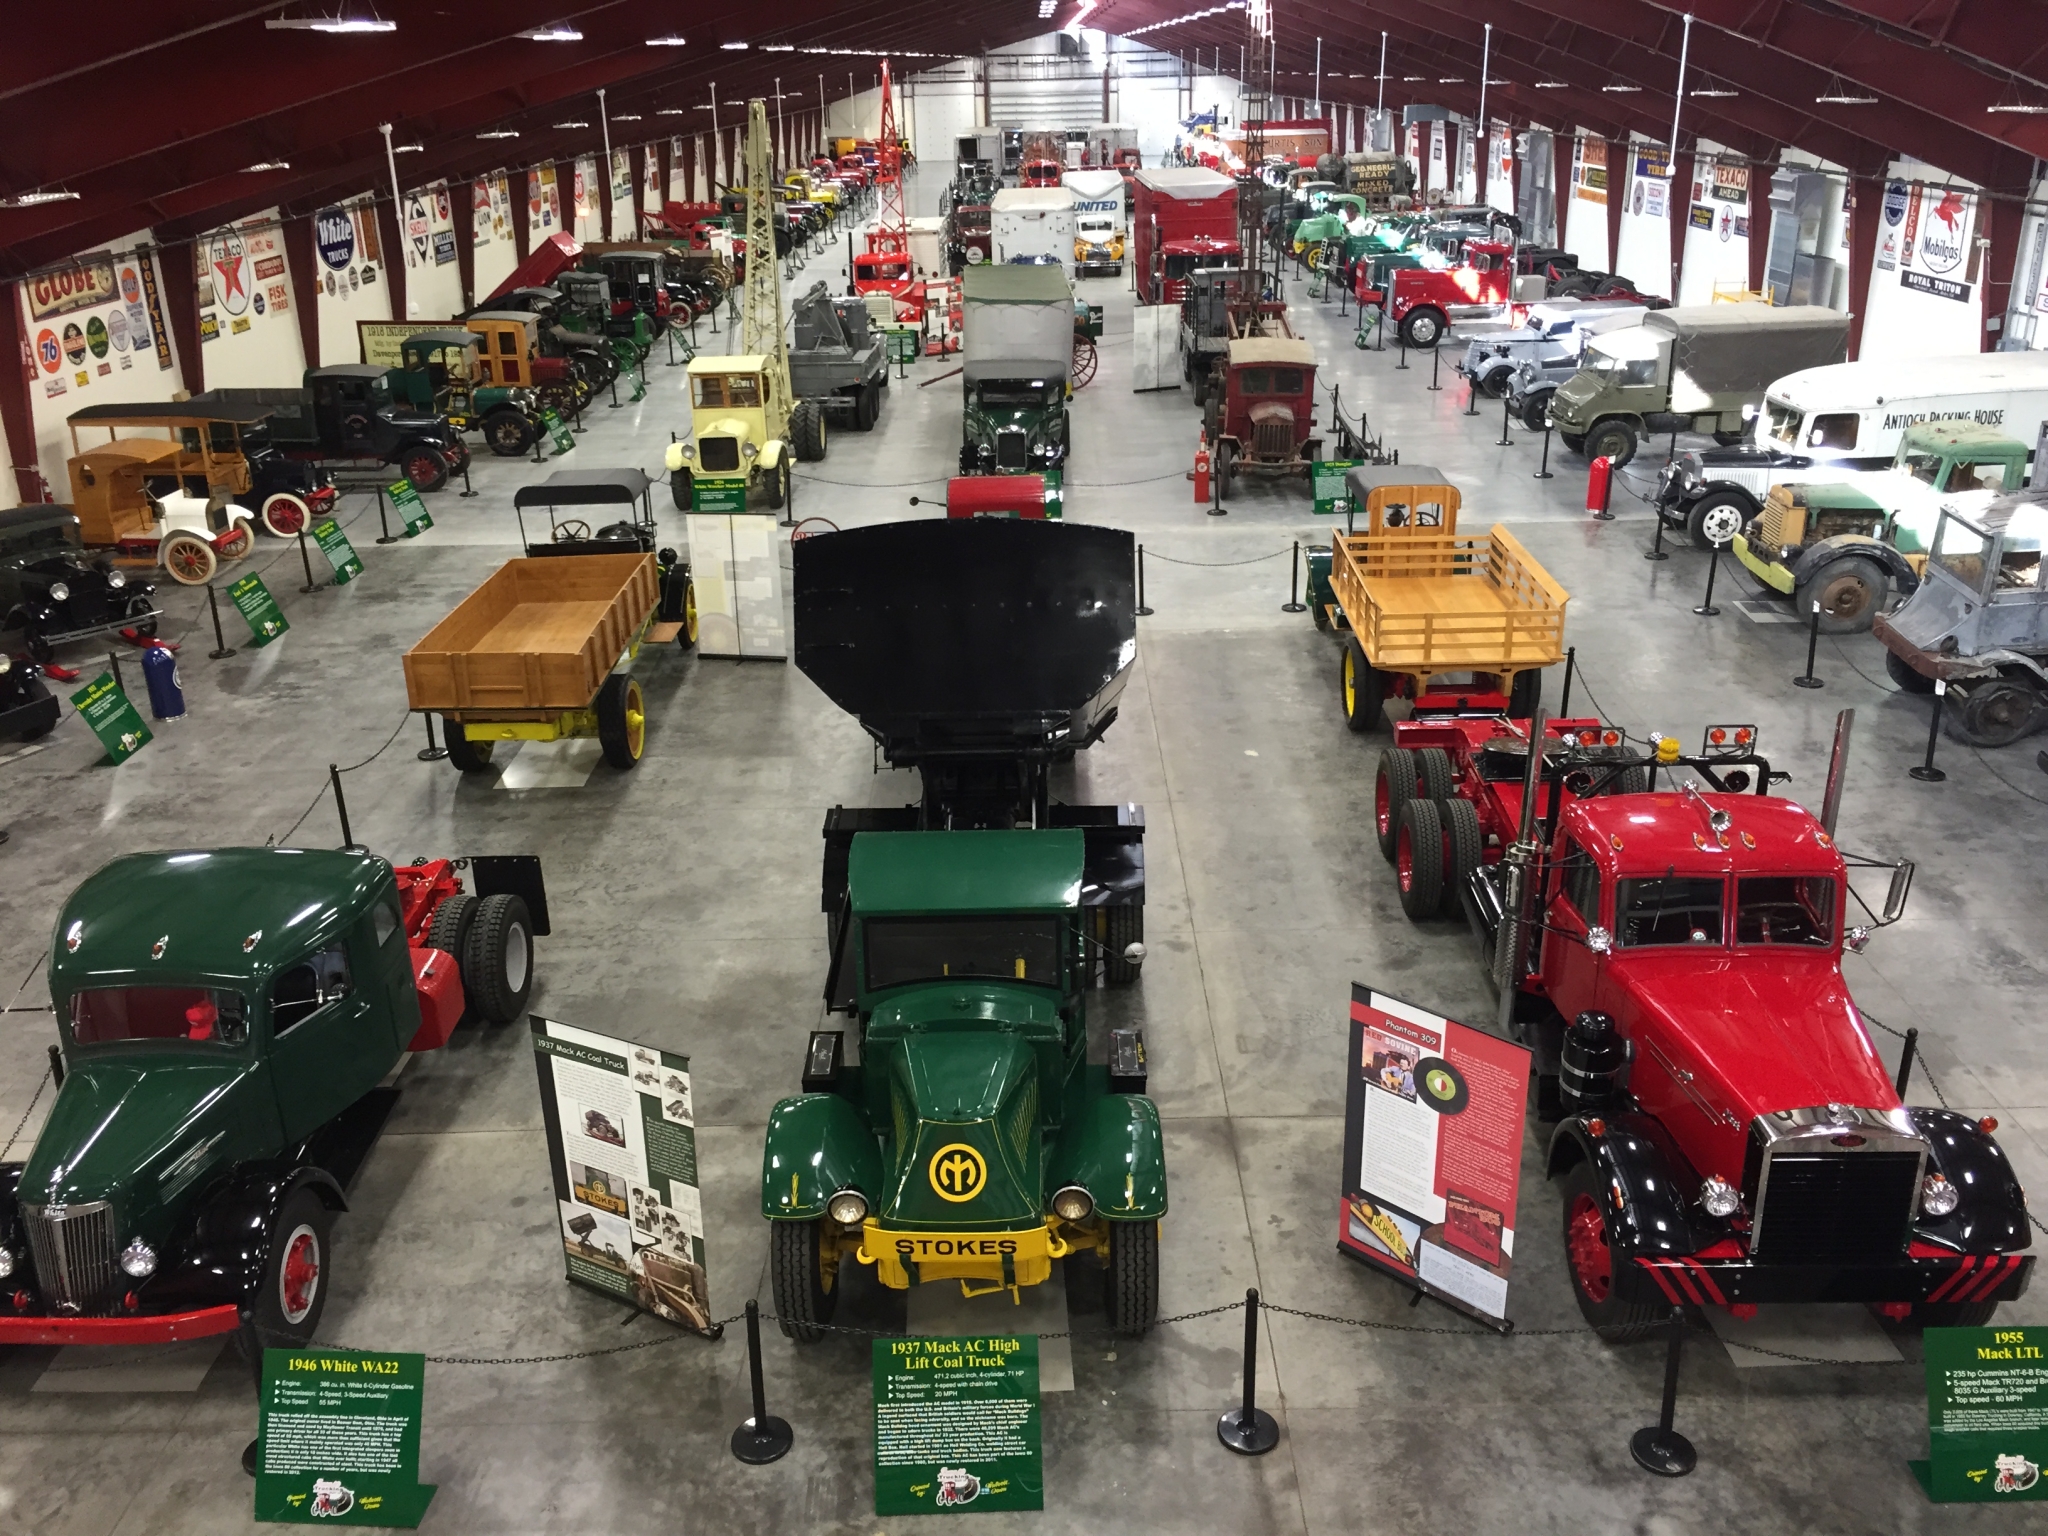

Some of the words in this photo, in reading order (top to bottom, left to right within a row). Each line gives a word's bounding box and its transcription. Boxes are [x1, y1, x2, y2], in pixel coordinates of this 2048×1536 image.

[1359, 170, 1389, 178] READY
[1715, 167, 1747, 188] TEXACO
[1357, 180, 1389, 188] MIXED
[1718, 187, 1740, 200] AHEAD
[1073, 200, 1118, 212] UNITED
[1906, 185, 1922, 235] DELCO
[318, 216, 352, 246] White
[213, 244, 242, 260] TEXACO
[327, 247, 350, 264] TRUCKS
[1924, 236, 1959, 263] Mobilgas
[35, 266, 97, 306] GLOBE
[268, 283, 287, 300] FISK
[1908, 273, 1931, 287] ROYAL
[1934, 280, 1962, 295] TRITON
[271, 299, 289, 312] TIRES
[367, 326, 385, 337] 1918
[41, 335, 58, 364] 76
[1974, 409, 2004, 425] HOUSE
[1385, 1019, 1419, 1039] Phantom
[1420, 1032, 1437, 1045] 309
[1365, 1029, 1383, 1042] RED
[1384, 1037, 1416, 1056] SOVINE
[537, 1038, 554, 1050] 1937
[556, 1043, 575, 1057] Mack
[575, 1049, 586, 1059] AC
[587, 1052, 602, 1064] Coal
[603, 1057, 625, 1070] Truck
[582, 1190, 619, 1207] STOKES
[1373, 1214, 1396, 1247] SCHOOL
[895, 1239, 1018, 1256] STOKES
[1994, 1332, 2024, 1344] 1955
[891, 1341, 920, 1355] 1937
[924, 1340, 961, 1354] Mack
[964, 1339, 985, 1353] AC
[988, 1338, 1020, 1355] High
[1977, 1347, 2013, 1360] Mack
[2016, 1346, 2044, 1359] LTL
[288, 1358, 317, 1371] 1946
[320, 1359, 358, 1373] White
[361, 1361, 399, 1374] WA22
[905, 1357, 930, 1370] Lift
[932, 1355, 963, 1369] Coal
[965, 1354, 1005, 1368] Truck
[1953, 1370, 1966, 1378] 235
[1967, 1371, 1976, 1379] hp
[1977, 1369, 2009, 1377] Cummins
[1953, 1379, 1982, 1388] 5-speed
[1982, 1378, 2001, 1386] Mack
[2001, 1378, 2024, 1386] TR720
[2025, 1377, 2038, 1385] and
[1979, 1386, 2009, 1395] Auxiliary
[2009, 1385, 2036, 1394] 3-speed
[1955, 1396, 1967, 1405] Top
[1968, 1396, 1990, 1404] speed
[2005, 1394, 2023, 1402] MPH
